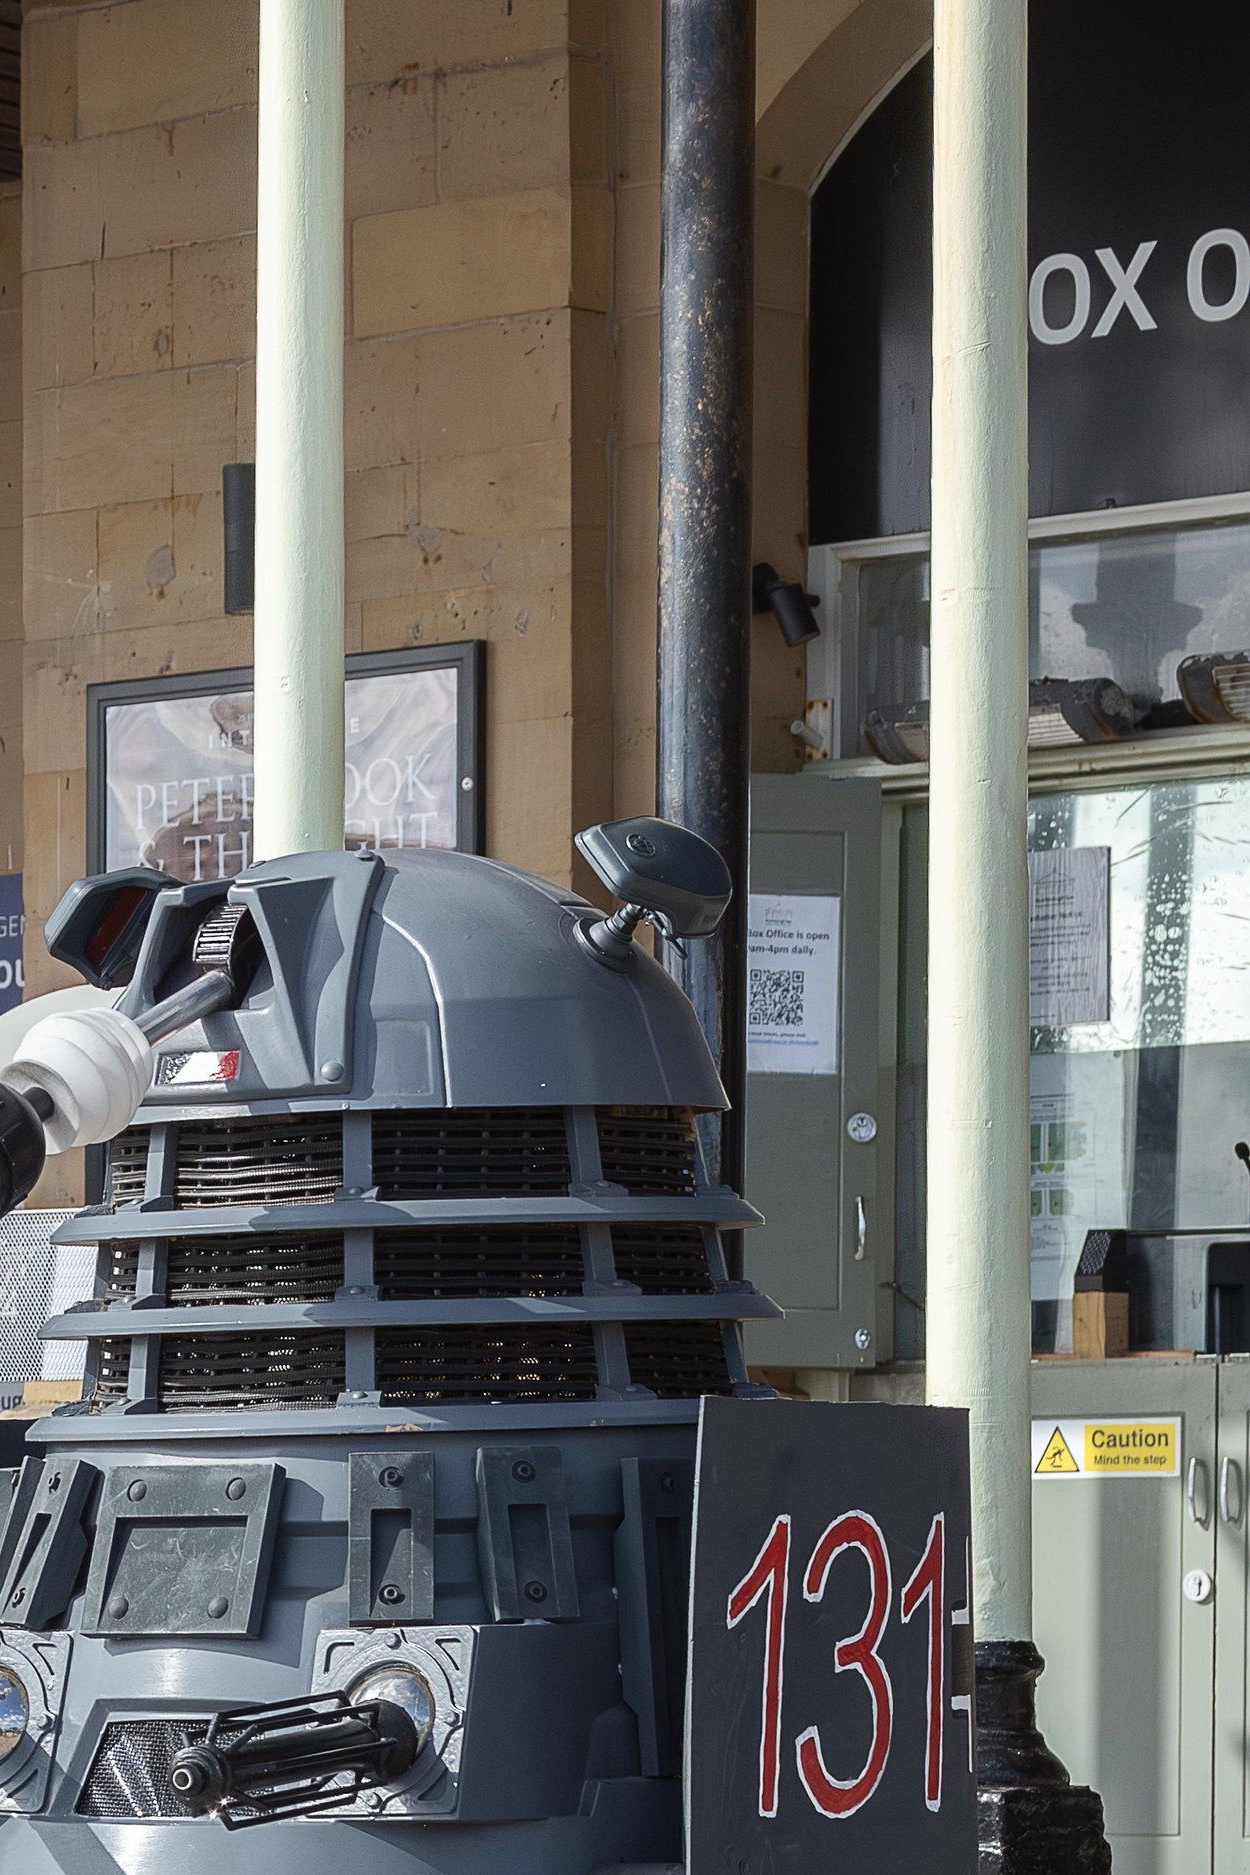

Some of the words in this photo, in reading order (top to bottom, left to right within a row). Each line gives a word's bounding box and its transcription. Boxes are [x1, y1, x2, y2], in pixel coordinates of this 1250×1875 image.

[1029, 239, 1158, 346] OX
[182, 830, 250, 882] TH
[766, 928, 795, 939] Office
[796, 929, 804, 940] is
[805, 931, 831, 942] open
[1091, 1428, 1170, 1449] Caution
[1094, 1454, 1121, 1465] Mind
[1123, 1453, 1141, 1465] the
[1143, 1454, 1167, 1467] step
[726, 1508, 945, 1820] 131
